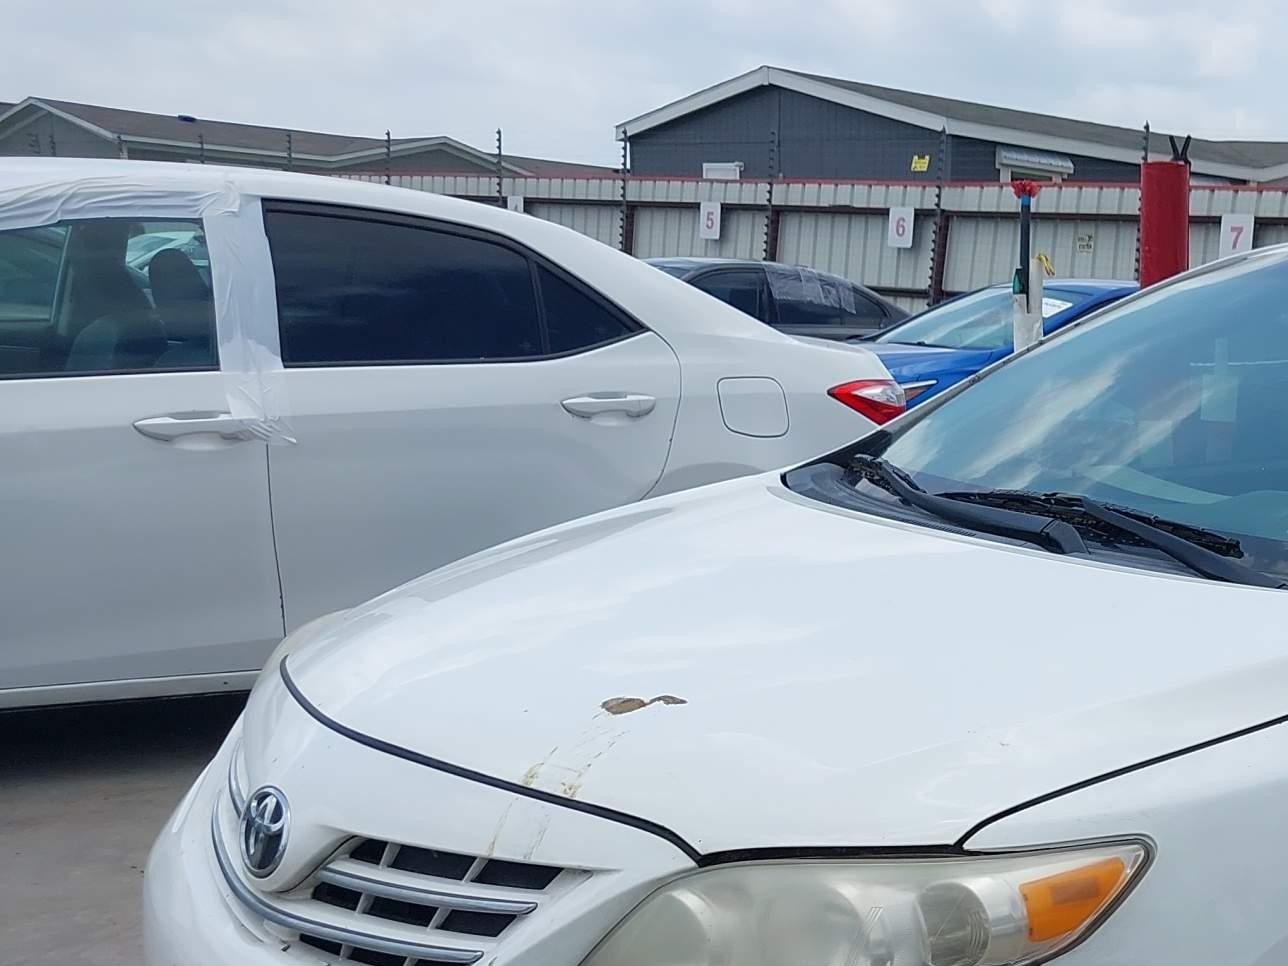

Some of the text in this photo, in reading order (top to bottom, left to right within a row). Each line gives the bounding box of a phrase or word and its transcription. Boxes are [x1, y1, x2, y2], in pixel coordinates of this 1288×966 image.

[706, 212, 714, 230] 5
[896, 217, 906, 237] 6
[1230, 226, 1244, 250] 7
